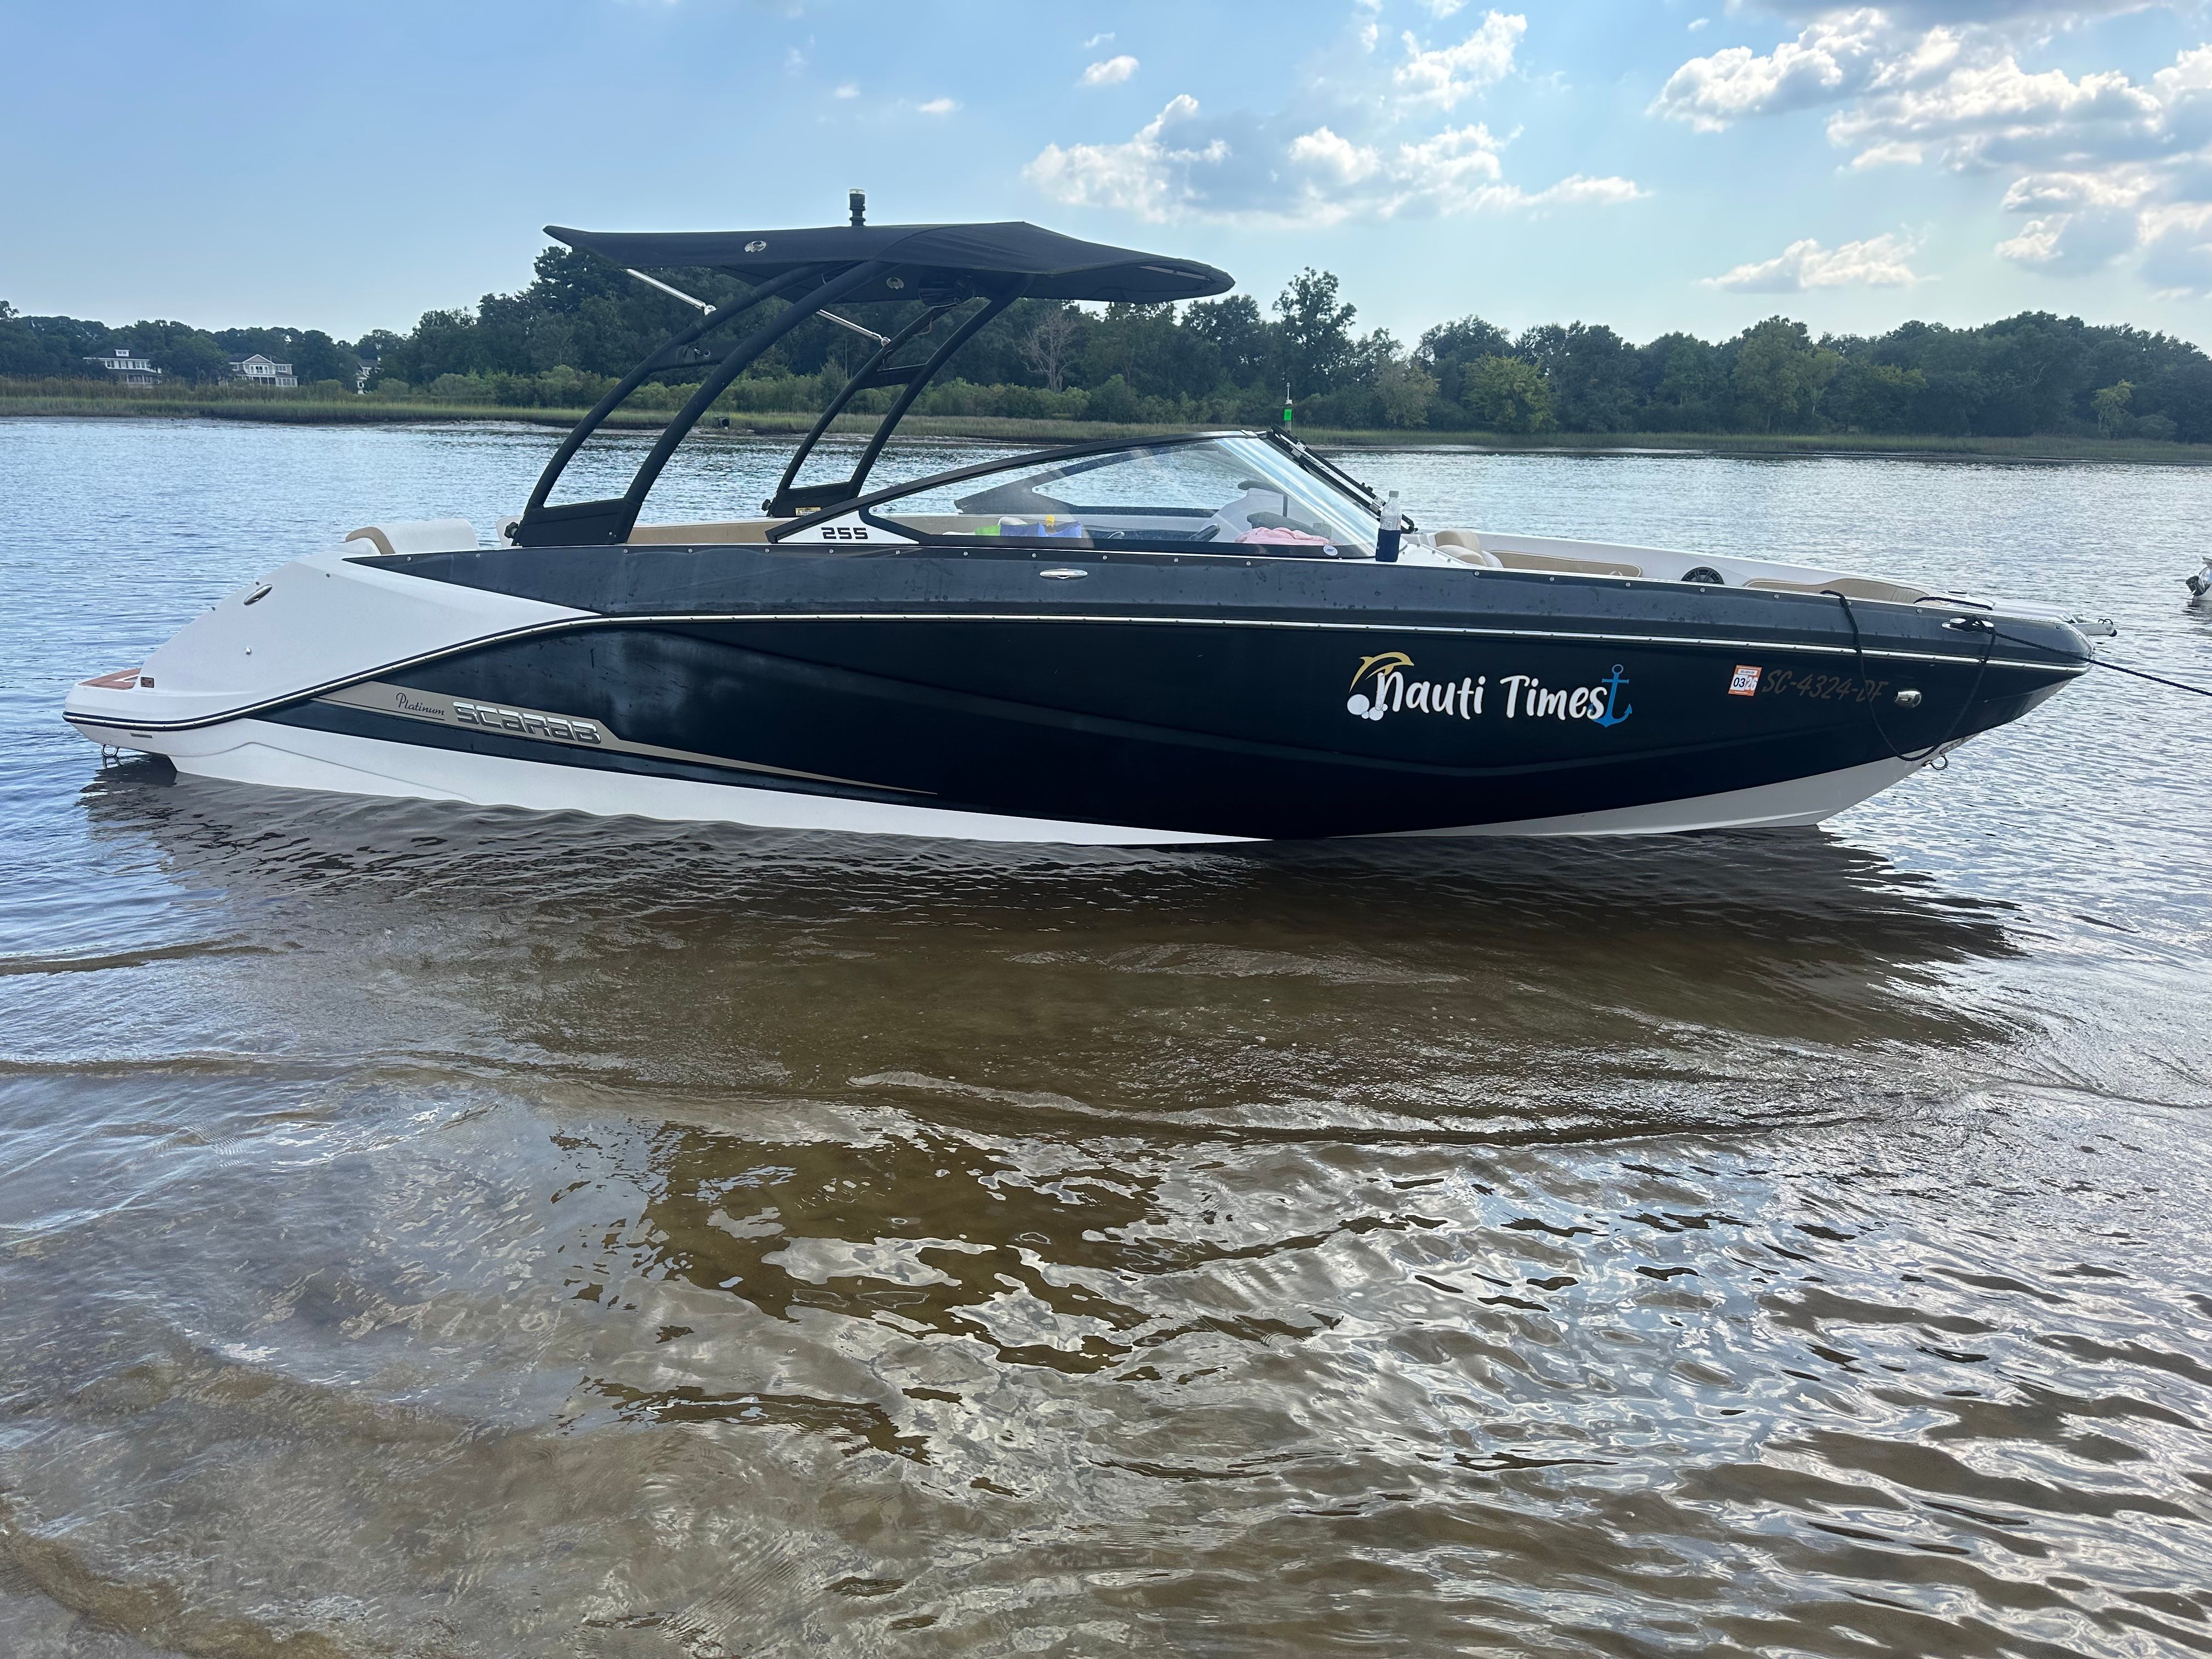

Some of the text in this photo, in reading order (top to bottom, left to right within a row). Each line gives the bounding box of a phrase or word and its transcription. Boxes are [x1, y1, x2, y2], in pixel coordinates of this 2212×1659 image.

[821, 527, 868, 540] 255
[1733, 676, 1758, 691] 03 26
[1761, 669, 1889, 703] SC-4324-DF
[396, 692, 445, 716] Platinum
[1377, 672, 1607, 721] Nauti Times
